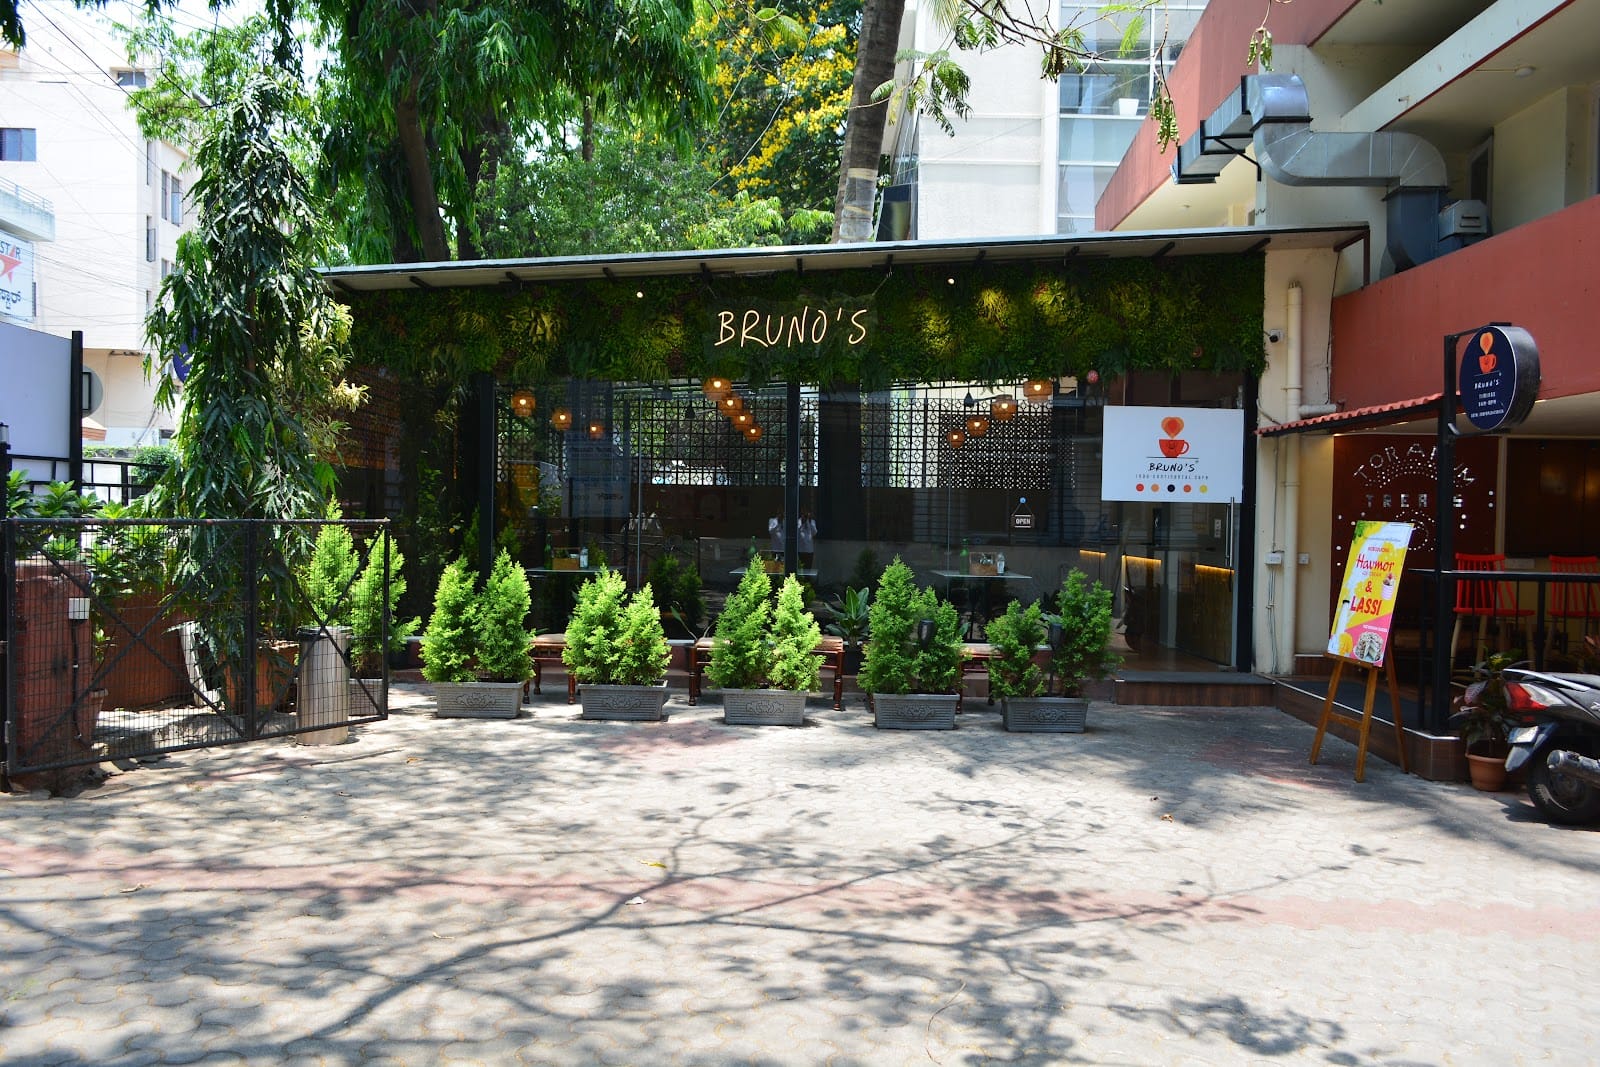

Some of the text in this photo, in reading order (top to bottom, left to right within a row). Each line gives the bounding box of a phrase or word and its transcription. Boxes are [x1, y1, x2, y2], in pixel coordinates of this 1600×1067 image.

[714, 306, 867, 348] BRUNO'S
[1148, 462, 1195, 472] BRUNO'S
[1365, 493, 1464, 508] TREAS
[1356, 553, 1395, 572] Havmor
[1365, 580, 1373, 593] &
[1350, 595, 1383, 616] LASSI
